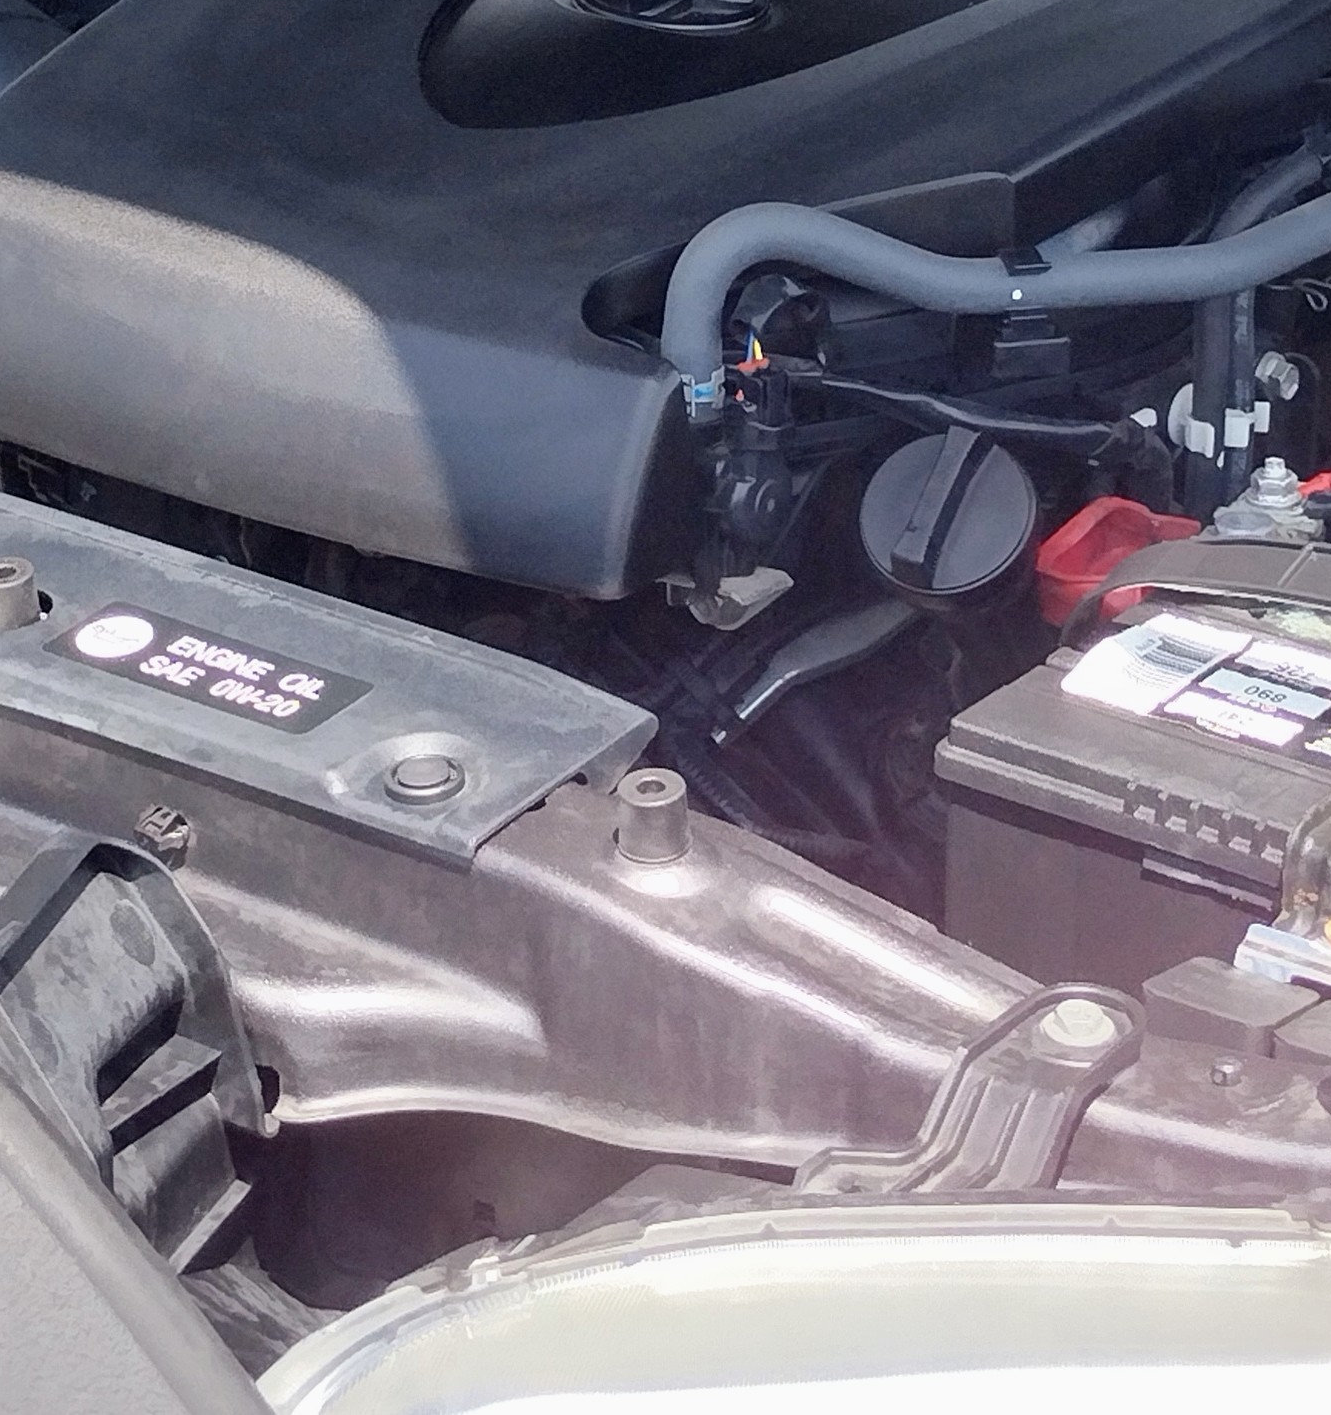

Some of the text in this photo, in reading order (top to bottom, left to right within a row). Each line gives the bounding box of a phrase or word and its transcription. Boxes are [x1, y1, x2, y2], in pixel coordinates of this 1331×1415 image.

[139, 655, 301, 717] SAE 0W-20
[166, 635, 325, 701] ENGINE OIL
[1243, 685, 1288, 704] 890
